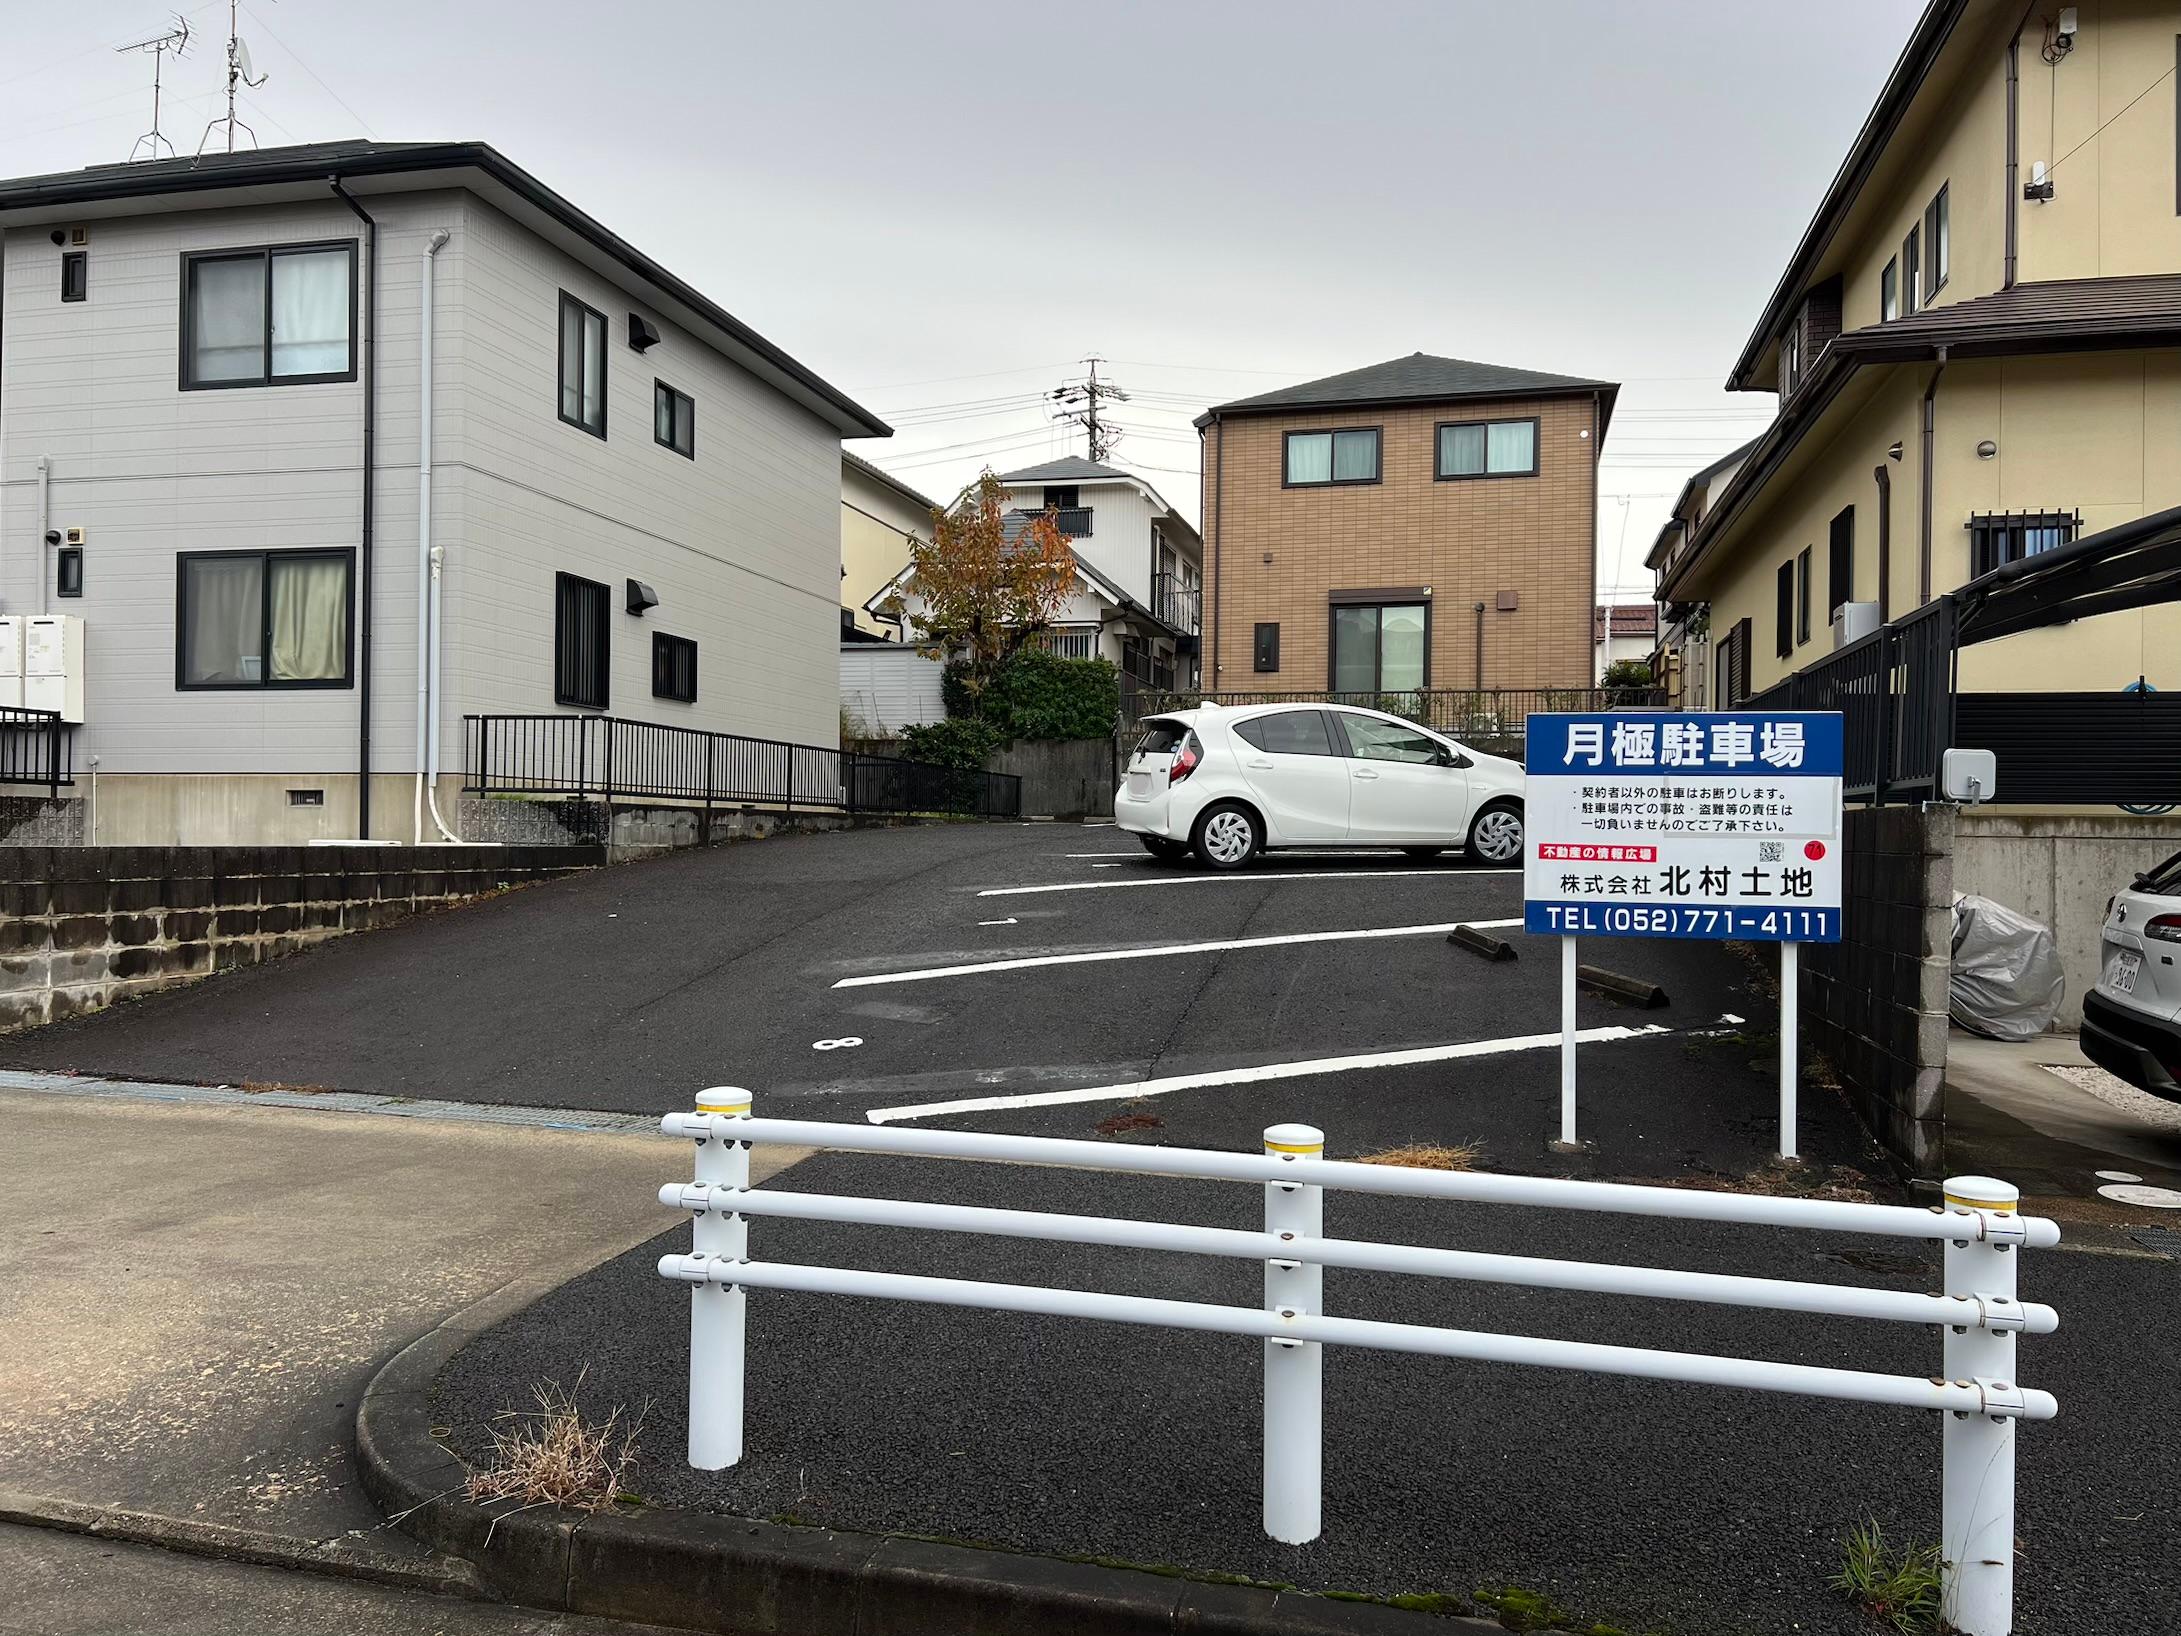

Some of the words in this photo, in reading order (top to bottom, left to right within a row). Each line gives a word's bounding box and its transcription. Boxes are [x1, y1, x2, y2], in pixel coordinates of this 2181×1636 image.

[1563, 721, 1806, 768] 月極駐車場
[1581, 819, 1785, 832] 一切負いませんのでご了承下さい。
[1543, 846, 1652, 860] 不動産の情報広場
